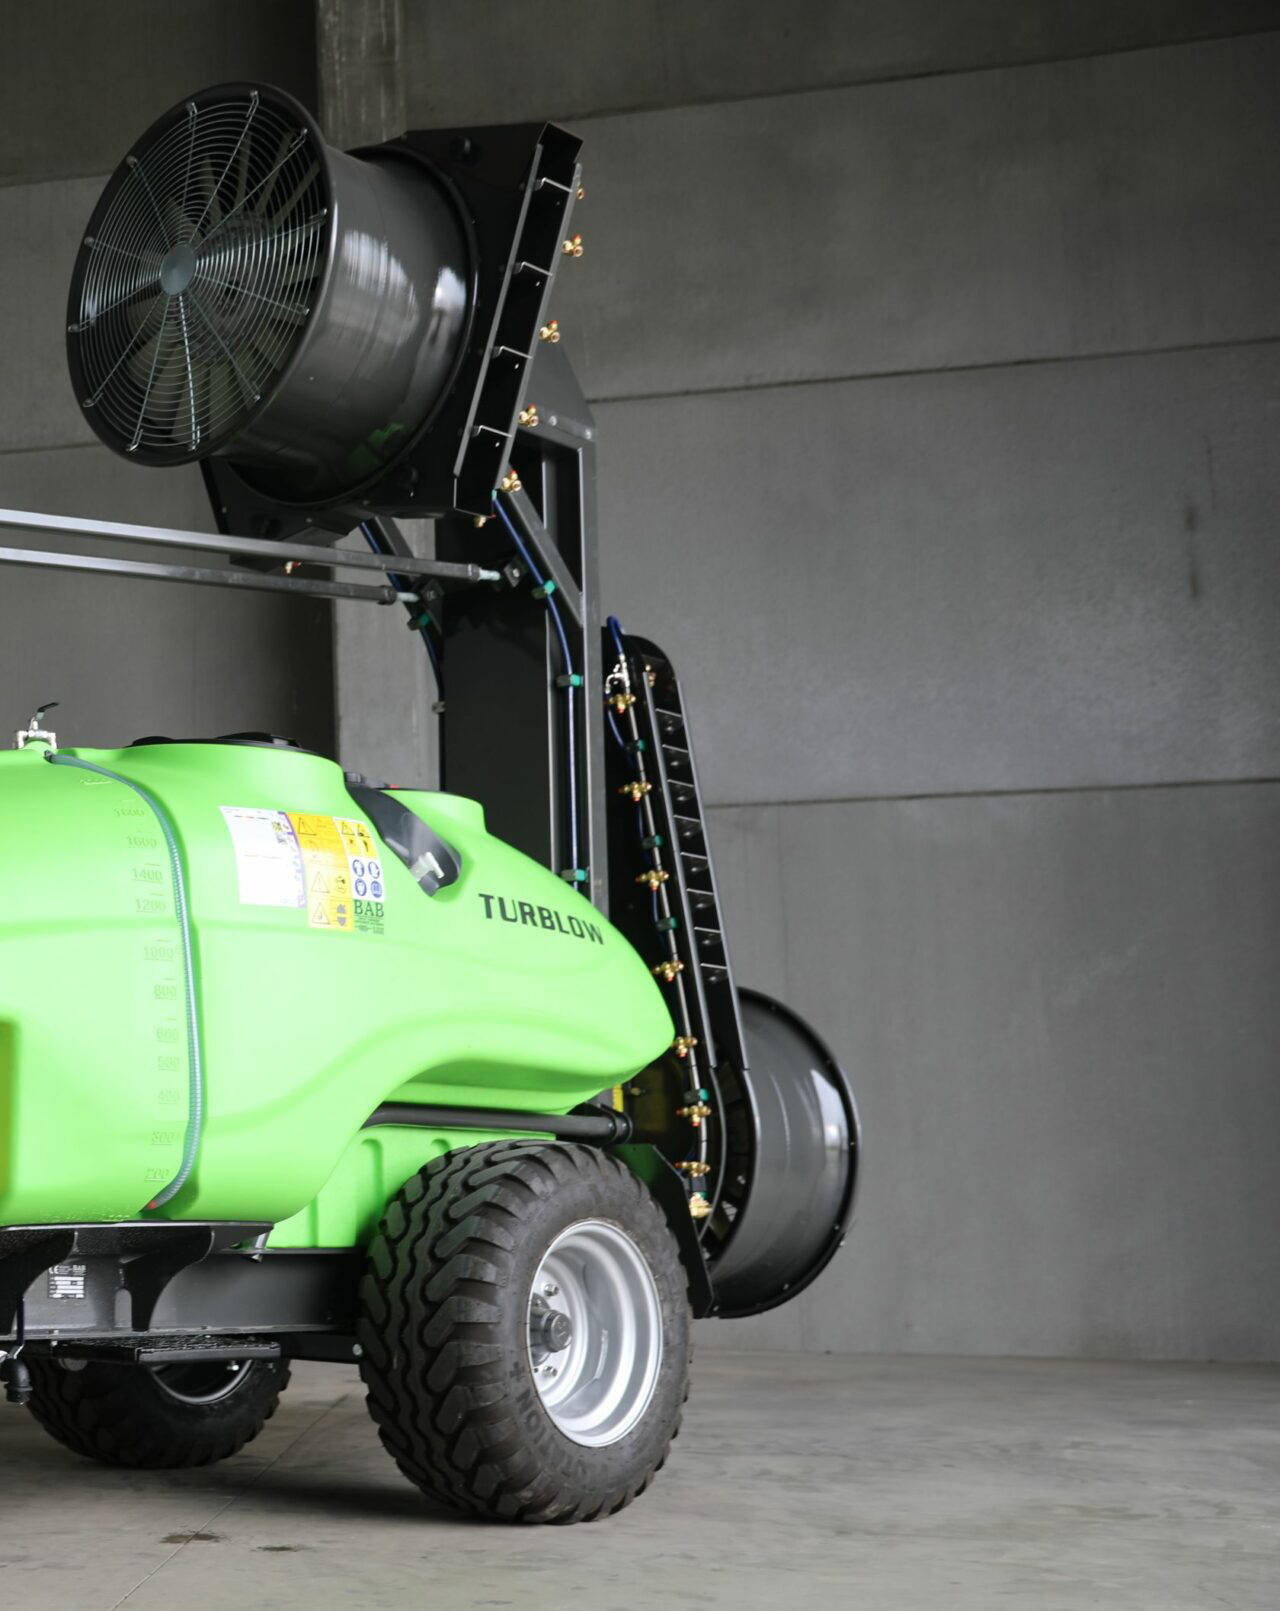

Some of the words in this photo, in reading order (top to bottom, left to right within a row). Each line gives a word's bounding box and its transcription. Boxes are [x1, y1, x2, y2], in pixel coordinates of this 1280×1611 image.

[131, 867, 163, 881] 1400
[354, 900, 384, 917] BAB
[478, 893, 604, 945] TURBLOW
[143, 946, 174, 959] 1000
